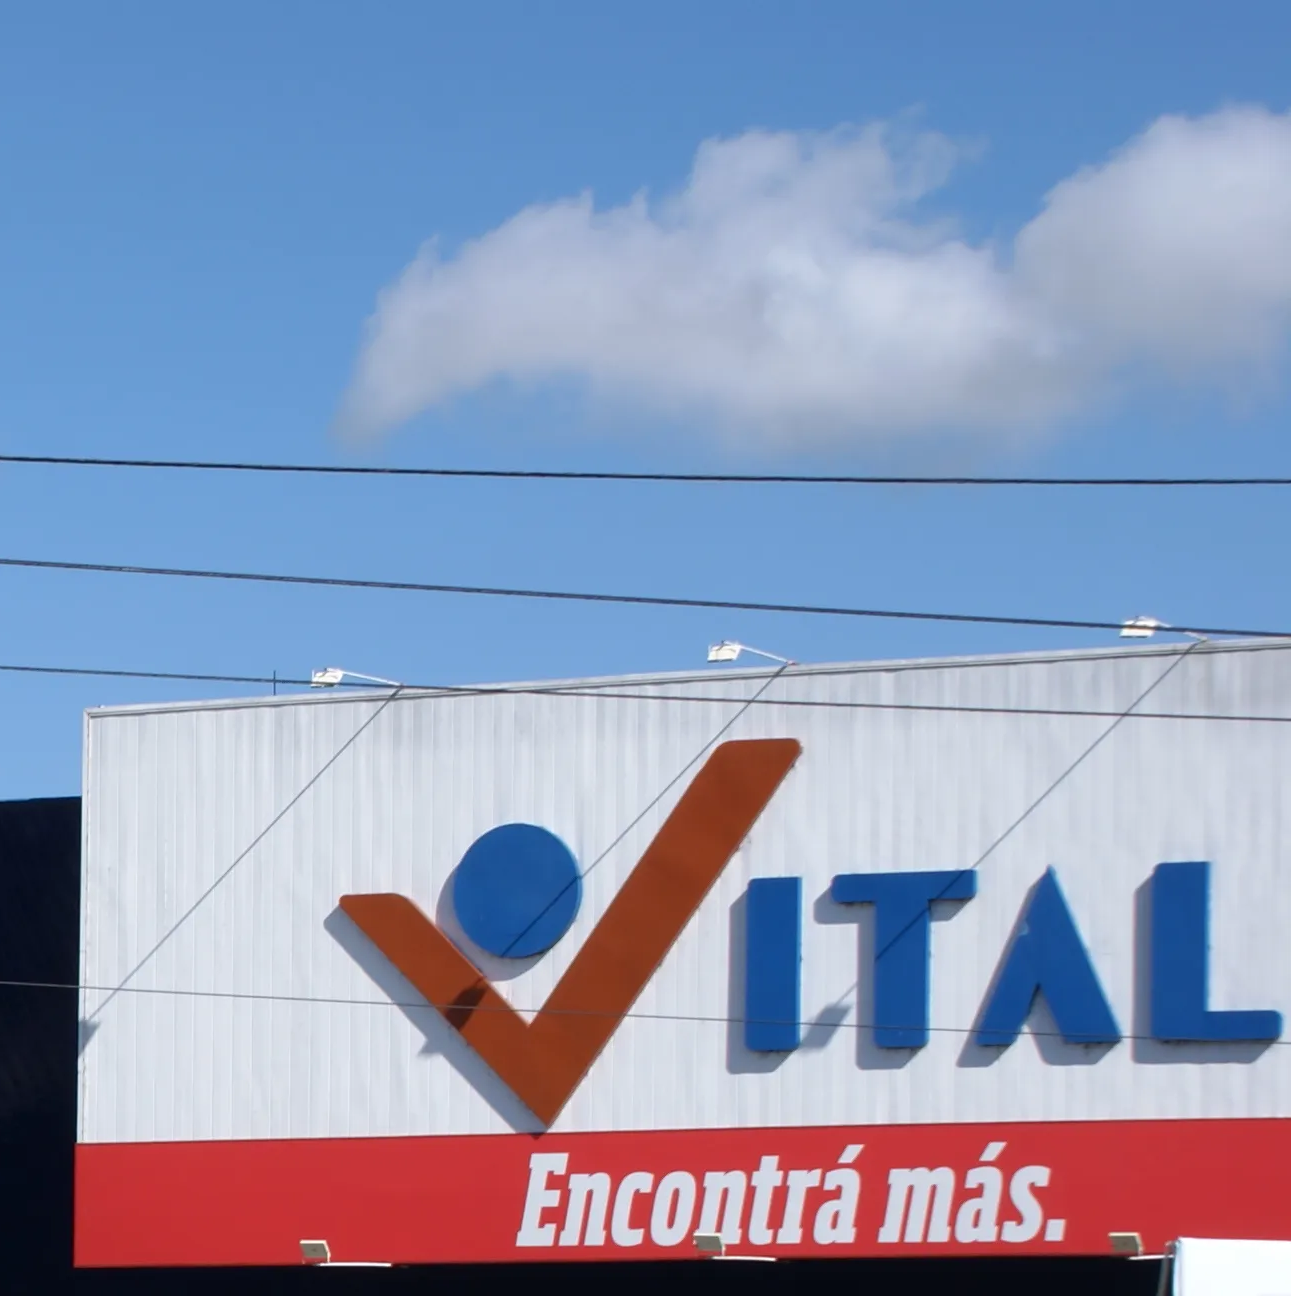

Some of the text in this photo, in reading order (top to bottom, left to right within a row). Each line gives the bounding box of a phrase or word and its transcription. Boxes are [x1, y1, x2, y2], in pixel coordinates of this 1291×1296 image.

[338, 738, 1283, 1126] VITAL
[515, 1141, 1067, 1248] Encontrá más.
